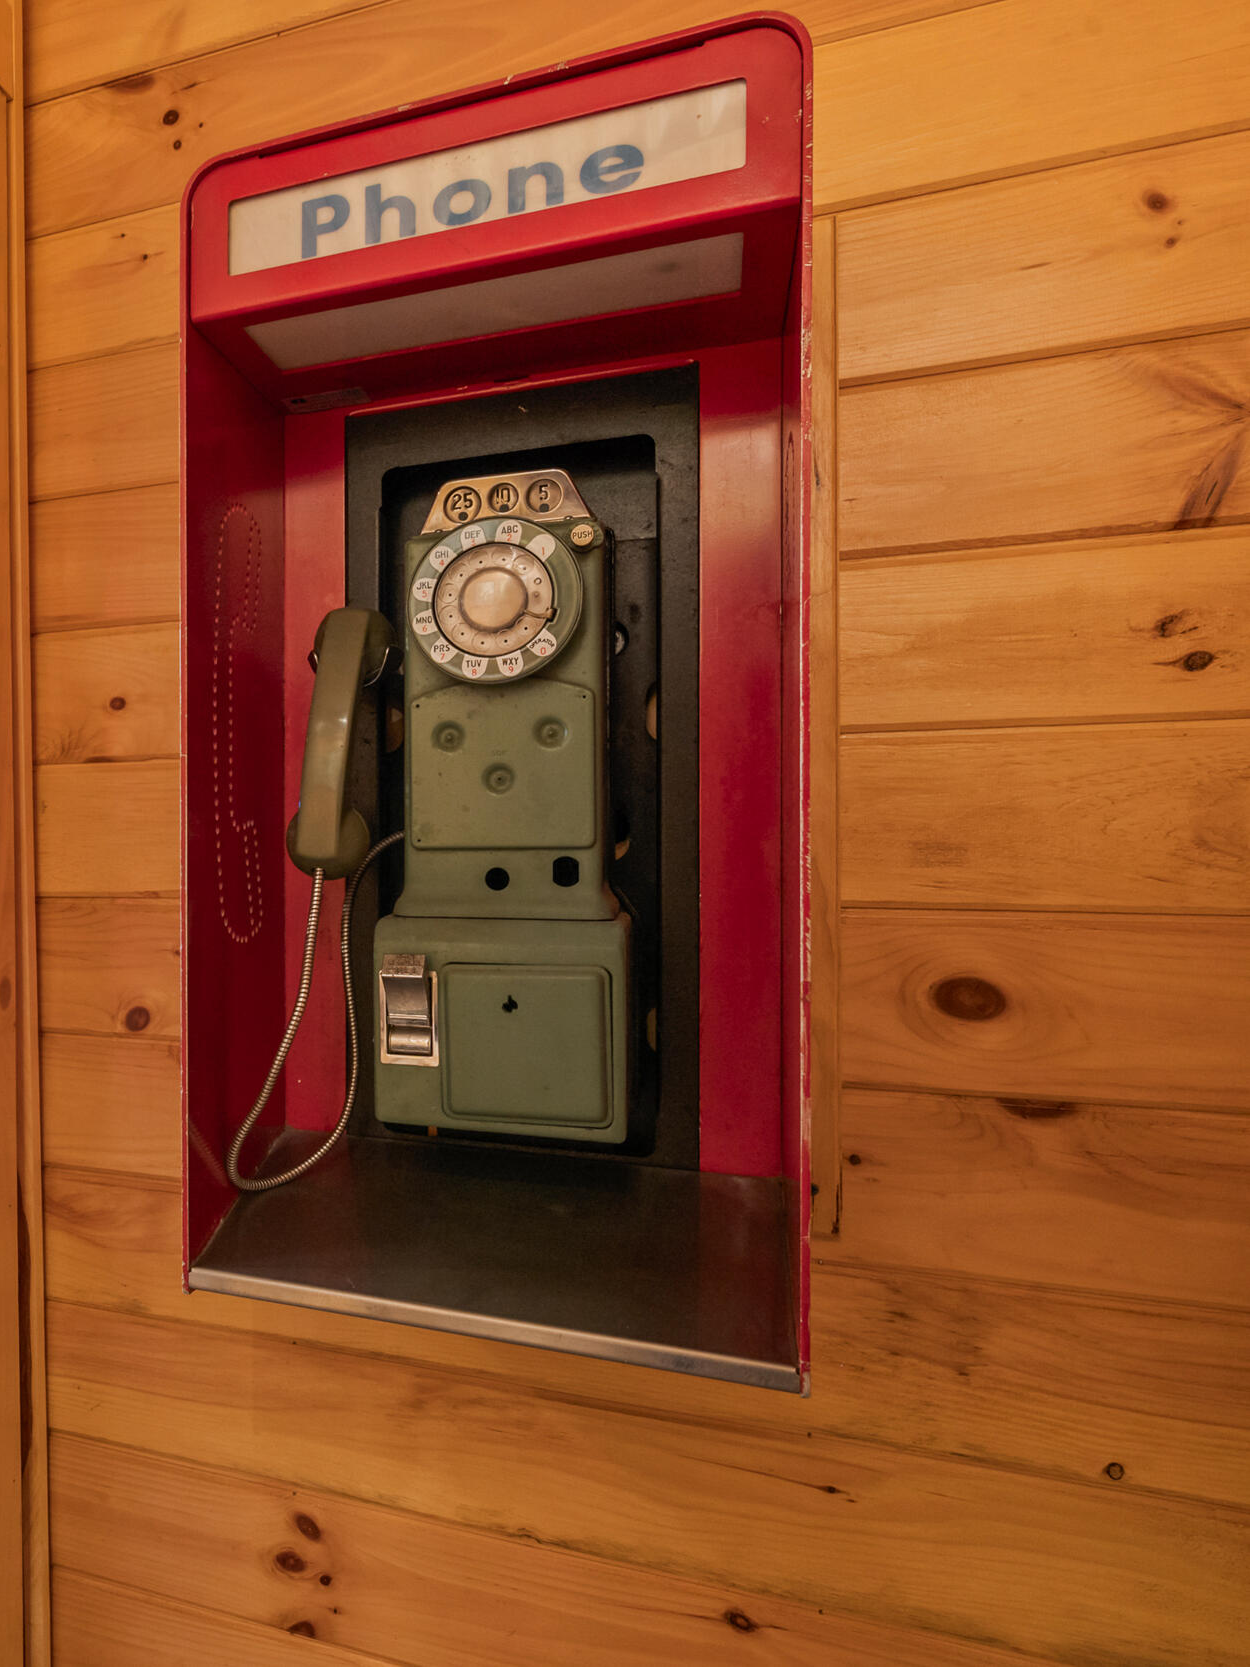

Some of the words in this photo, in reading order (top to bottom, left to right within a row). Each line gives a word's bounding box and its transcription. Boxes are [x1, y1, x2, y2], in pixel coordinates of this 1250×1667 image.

[300, 143, 646, 260] Phone
[495, 486, 511, 504] 10
[538, 484, 550, 501] 5
[452, 492, 474, 511] 25
[501, 524, 519, 535] ABC
[464, 530, 481, 540] DEF
[506, 533, 512, 542] 2
[572, 529, 593, 541] PUSH
[434, 550, 450, 560] GHI
[438, 559, 445, 567] 4
[416, 581, 433, 591] JKL
[421, 589, 428, 598] 5
[415, 615, 433, 625] MNO
[422, 624, 428, 632] 6
[433, 643, 451, 653] PRS
[529, 637, 555, 649] OPERATOR
[539, 647, 547, 656] 0
[439, 653, 446, 662] 7
[502, 656, 519, 667] WXY
[466, 659, 483, 669] TUV
[471, 668, 477, 677] 8
[507, 665, 514, 674] 9
